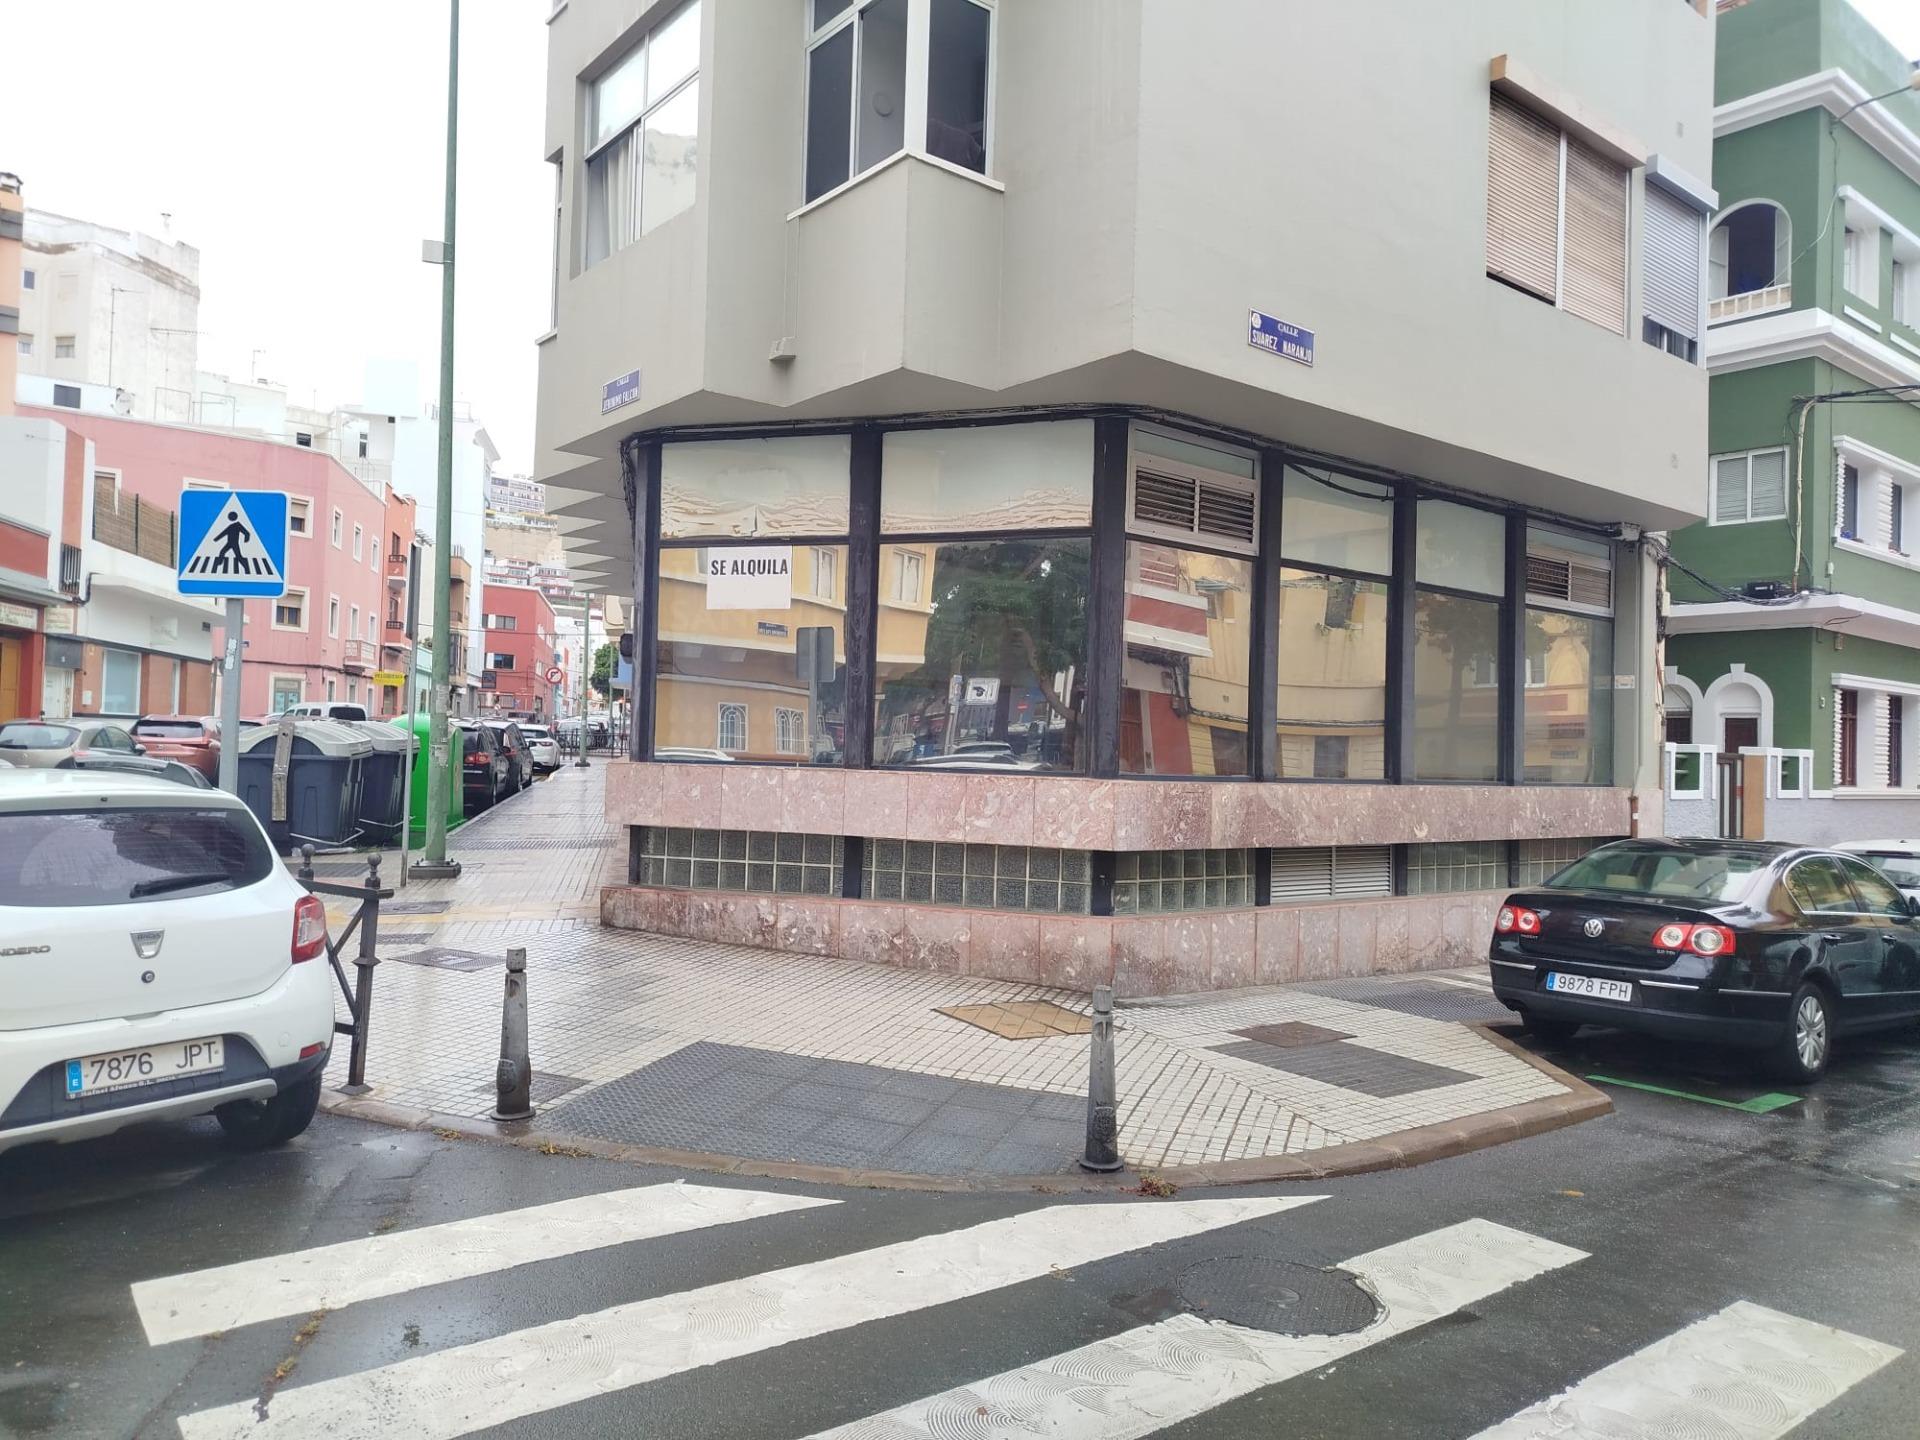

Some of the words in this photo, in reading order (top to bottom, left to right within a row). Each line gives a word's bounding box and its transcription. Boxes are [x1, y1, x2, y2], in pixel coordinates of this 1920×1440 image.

[1277, 323, 1299, 337] CALLE
[1252, 330, 1277, 350] SUAREZ
[1282, 340, 1312, 362] NARANJO
[711, 559, 727, 576] SE
[731, 558, 788, 577] ALQUILA
[1558, 976, 1594, 993] 9878
[1599, 981, 1628, 998] FPH
[72, 1078, 79, 1087] E
[90, 1052, 153, 1085] 7876
[176, 1041, 216, 1069] JPT
